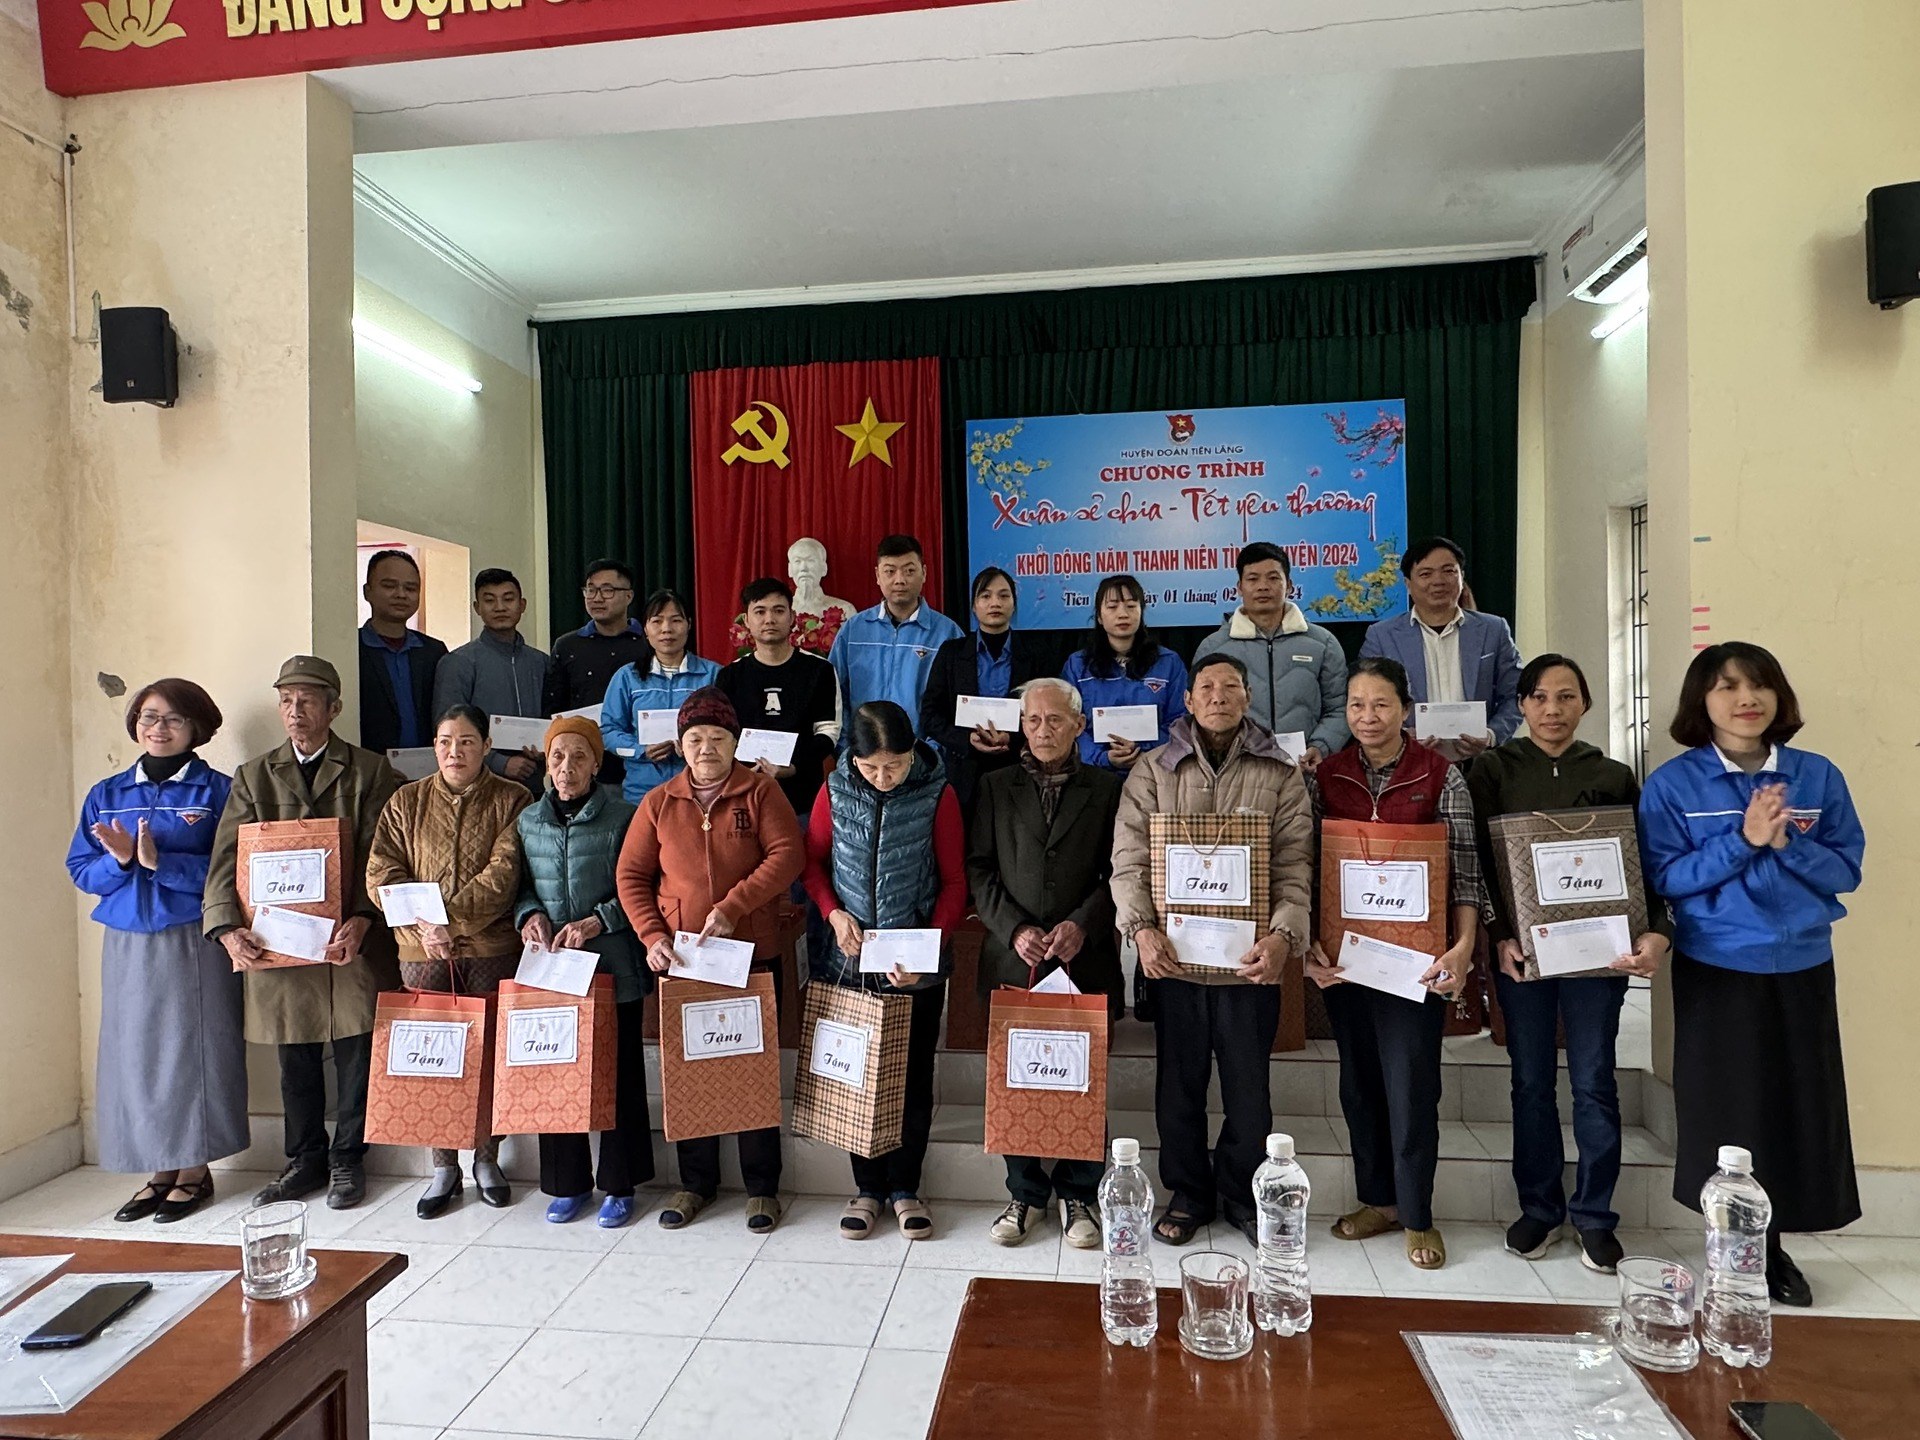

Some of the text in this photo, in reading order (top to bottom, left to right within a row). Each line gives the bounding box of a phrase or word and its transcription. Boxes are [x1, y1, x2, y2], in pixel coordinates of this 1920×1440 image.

[1121, 444, 1243, 458] HUYỆN ĐOÀN TIÊN LÃNG
[1100, 459, 1265, 482] CHƯƠNG TRÌNH
[992, 493, 1069, 530] Xuân
[1073, 494, 1104, 521] sẻ
[1107, 492, 1163, 524] chia
[1181, 487, 1230, 522] Tết
[1236, 492, 1280, 542] yêu
[1017, 541, 1358, 579] KHỞI ĐỘNG NĂM THANH NIÊN TÌ YỆN 2024
[1164, 590, 1178, 603] 01
[1184, 589, 1217, 605] tháng
[1222, 587, 1237, 602] 02
[1287, 585, 1303, 600] 24
[1185, 877, 1228, 892] Tặng
[1559, 876, 1604, 891] Tặng
[1361, 893, 1406, 908] Tặng
[703, 1031, 742, 1045] Tặng
[523, 1040, 559, 1054] Tặng
[407, 1052, 444, 1067] Tặng
[823, 1052, 850, 1072] Tặng
[1027, 1061, 1068, 1078] Tặng
